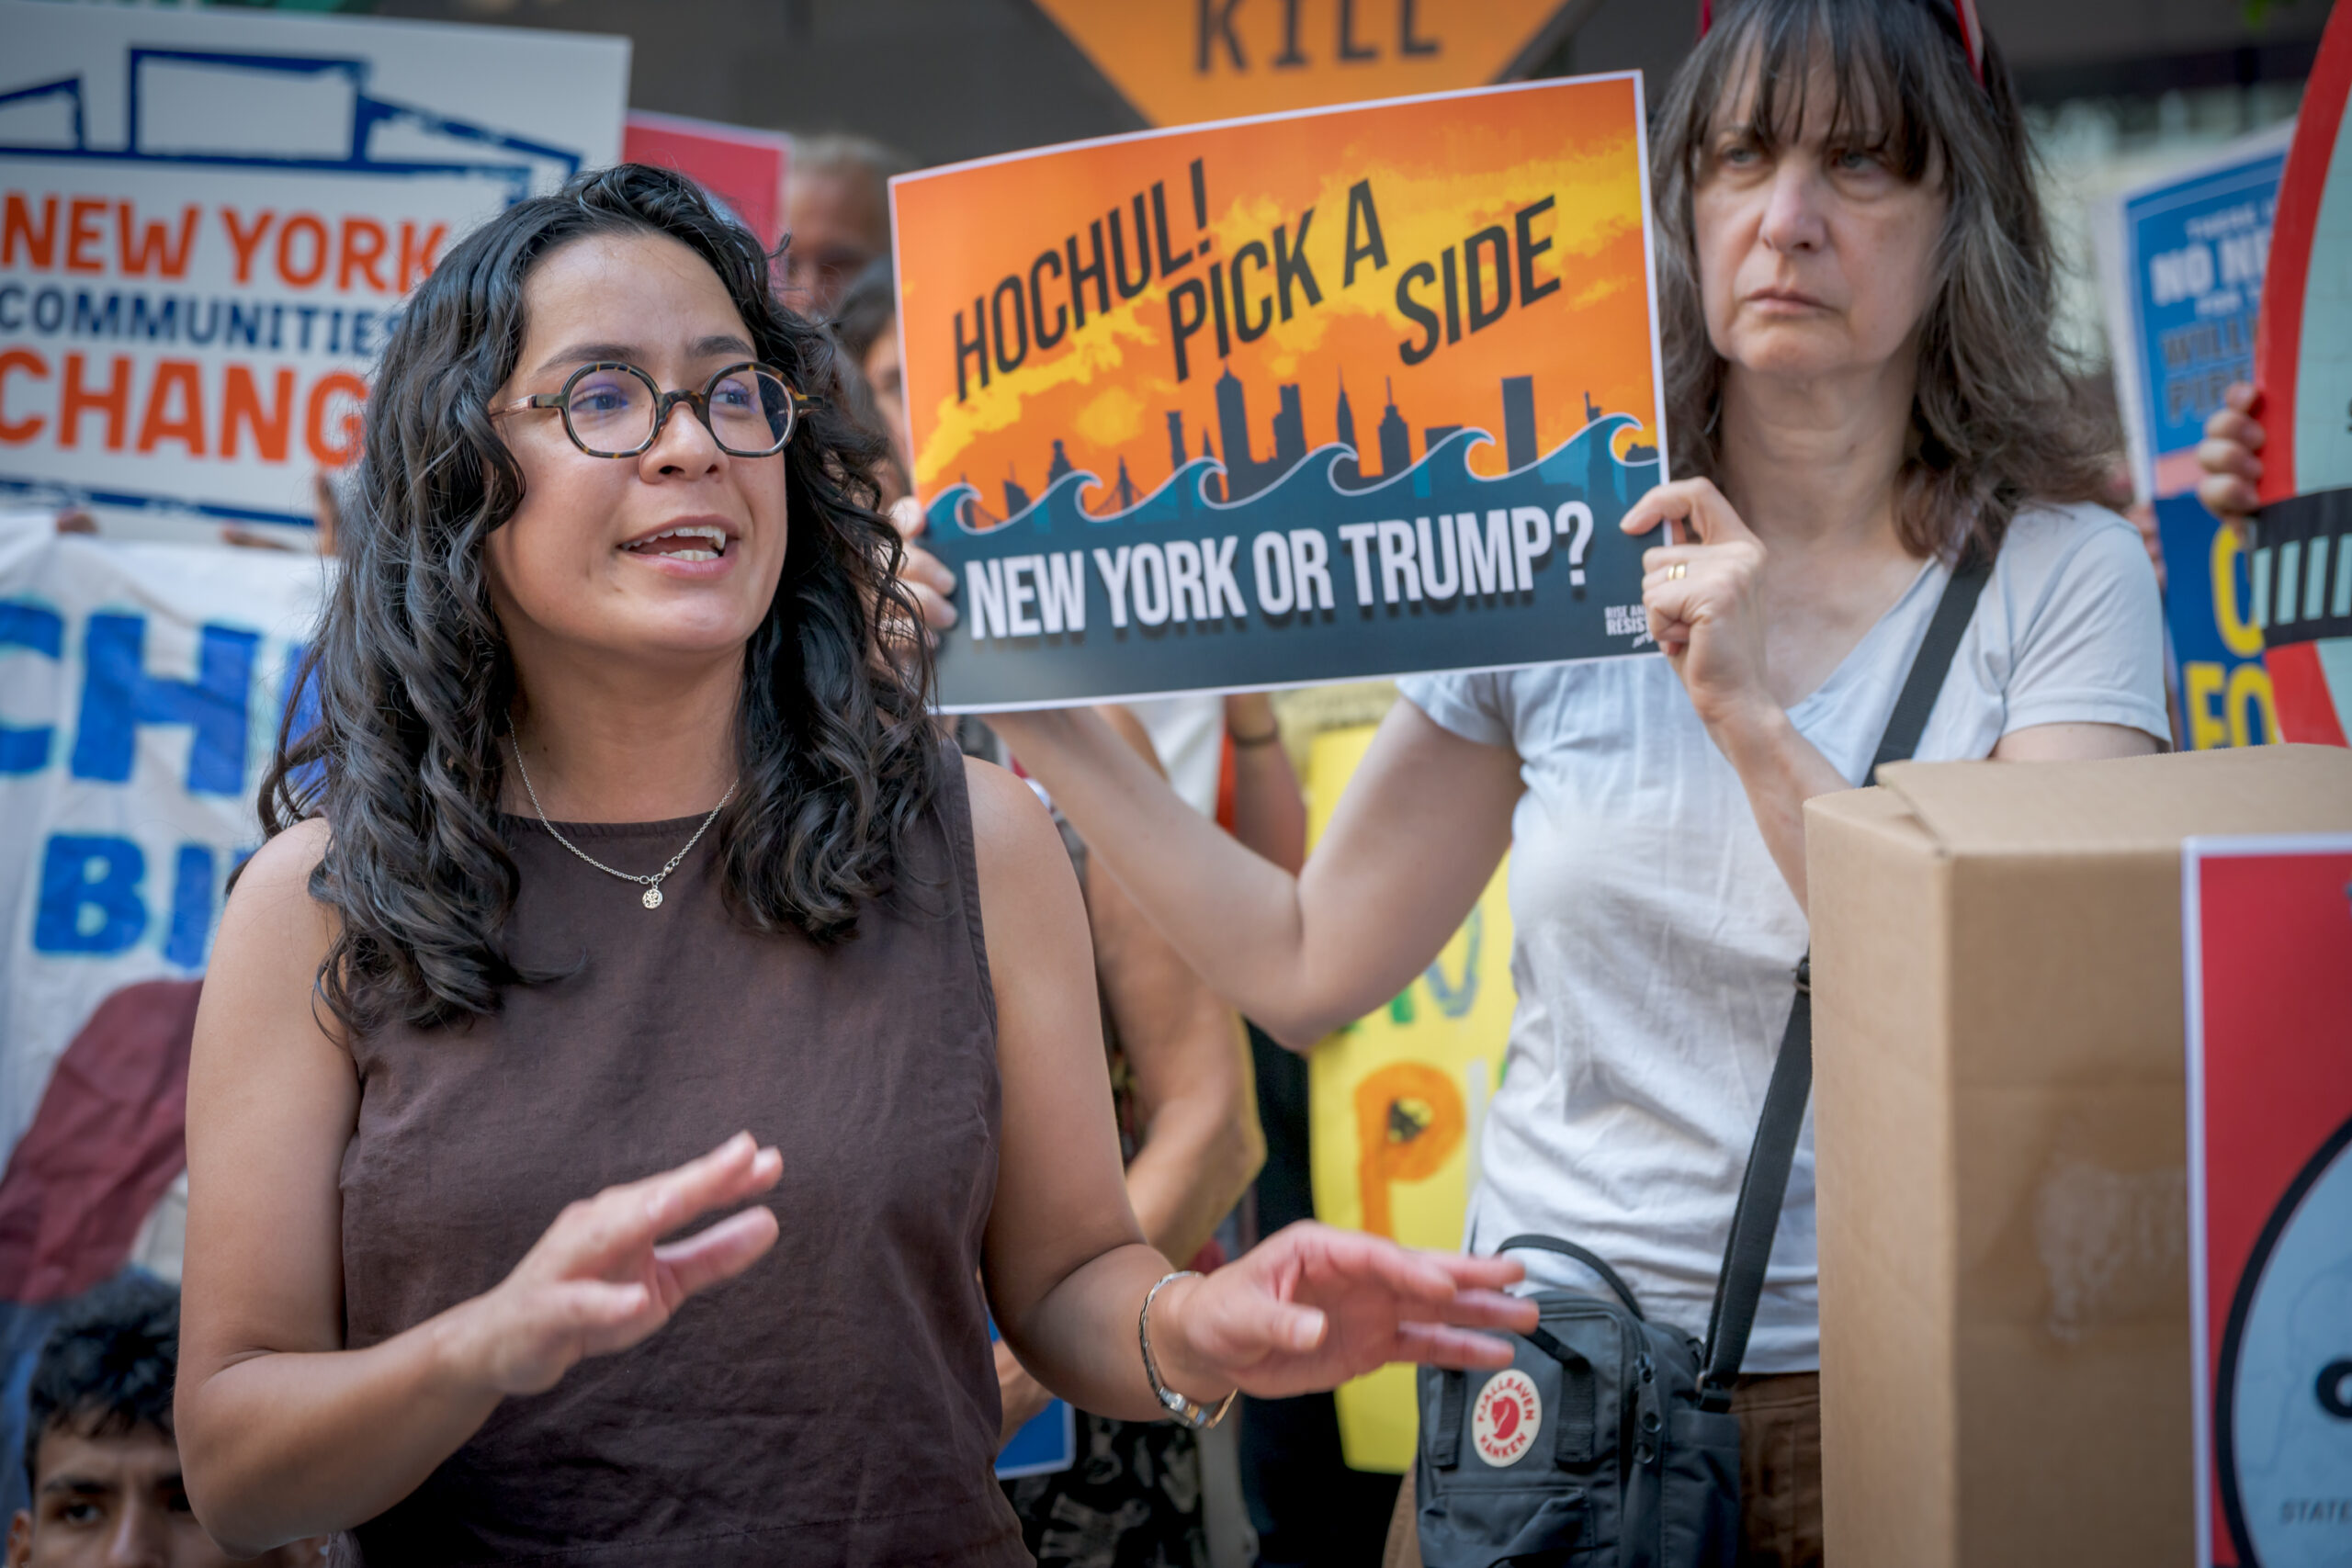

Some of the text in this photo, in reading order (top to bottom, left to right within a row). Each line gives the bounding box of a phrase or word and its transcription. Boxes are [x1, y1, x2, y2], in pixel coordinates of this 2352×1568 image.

[1193, 0, 1440, 73] KILL
[2, 189, 447, 294] NEW YORK
[952, 157, 1212, 402] HOCHUL!
[1168, 178, 1390, 381] PICK A
[1395, 194, 1562, 366] SIDE
[0, 345, 369, 469] CHANG
[966, 501, 1594, 639] NEW YORK OR TRUMP?
[1630, 604, 1646, 618] AN
